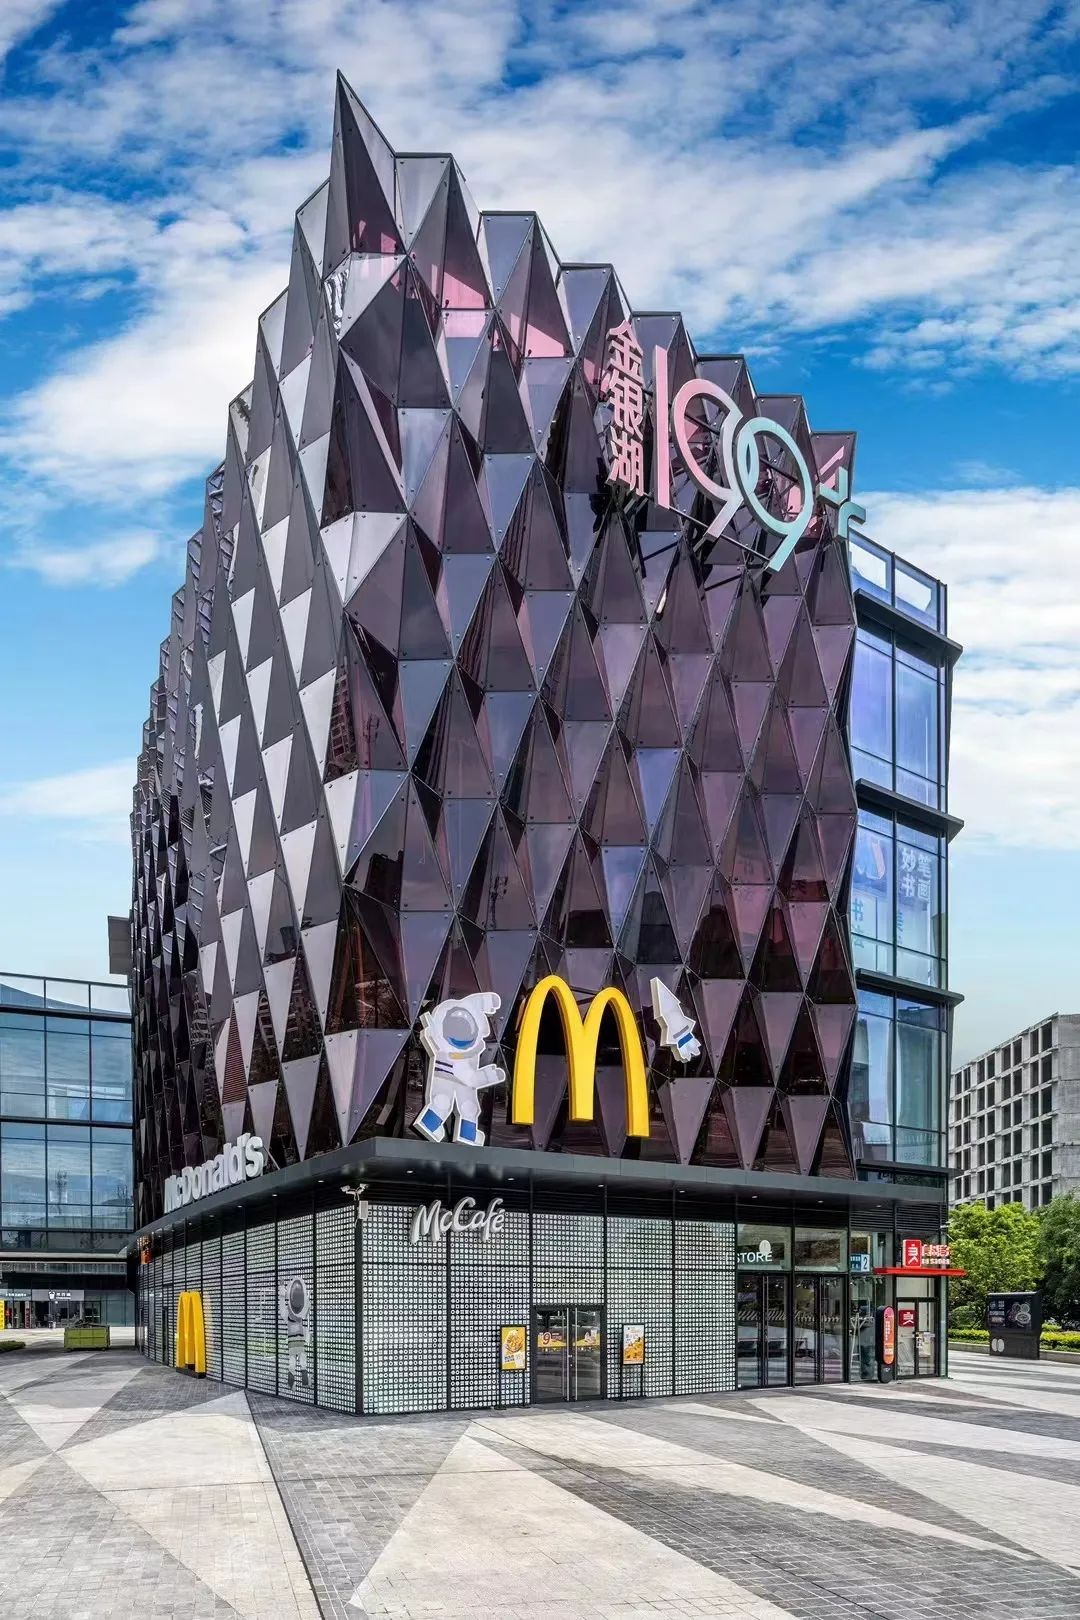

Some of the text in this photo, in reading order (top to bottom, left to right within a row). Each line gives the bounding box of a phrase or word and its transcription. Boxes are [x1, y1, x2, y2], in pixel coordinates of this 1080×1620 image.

[164, 1132, 266, 1214] McDonald's
[409, 1197, 506, 1243] McCafé
[863, 1256, 868, 1270] 2
